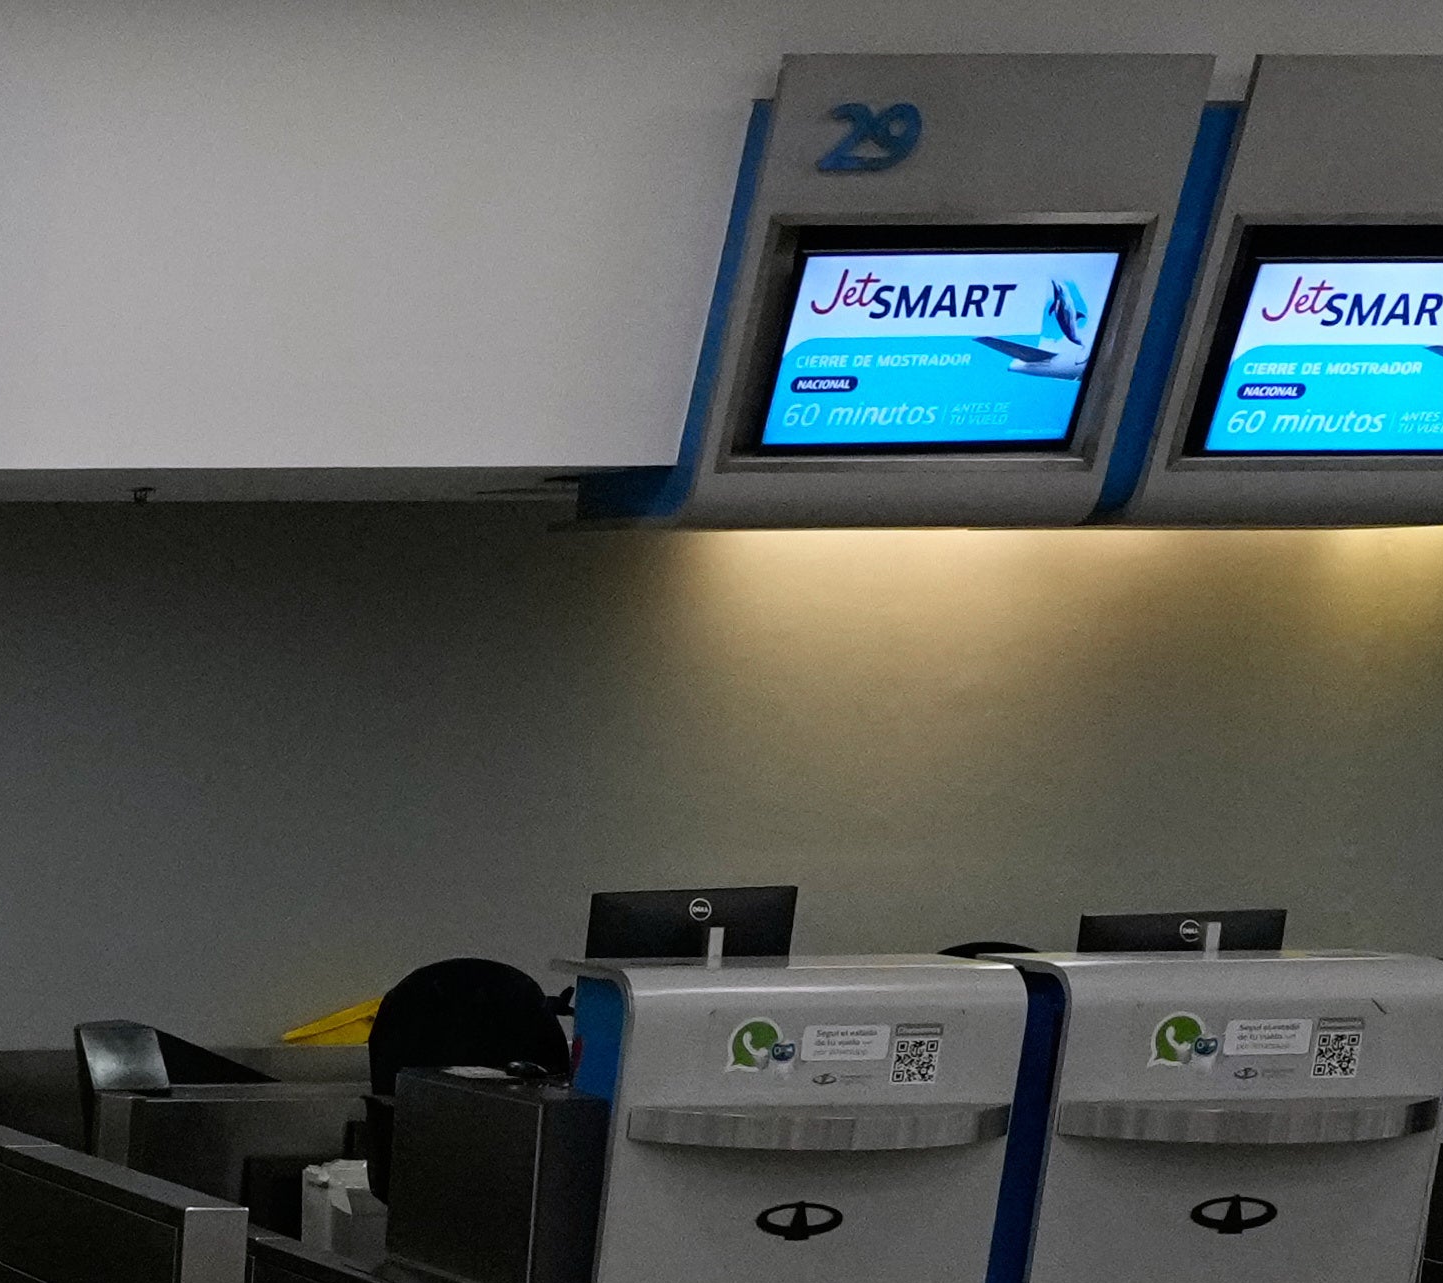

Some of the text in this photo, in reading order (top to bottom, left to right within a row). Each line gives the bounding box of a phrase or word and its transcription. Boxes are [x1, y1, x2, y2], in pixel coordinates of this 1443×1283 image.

[817, 102, 923, 173] 29
[810, 268, 1018, 320] JetSMART
[796, 353, 971, 368] CIERRE DE MOSTRADOR
[1243, 361, 1423, 375] CIERRE DE MOSTRADOR
[797, 379, 851, 391] NACIONAL
[1243, 386, 1299, 397] NACIONAL
[783, 401, 937, 426] 60 minutos
[951, 402, 1011, 414] ANTES DE
[968, 413, 1008, 425] VUELO
[1227, 408, 1386, 434] 60 minutos
[1400, 411, 1441, 423] ANTES
